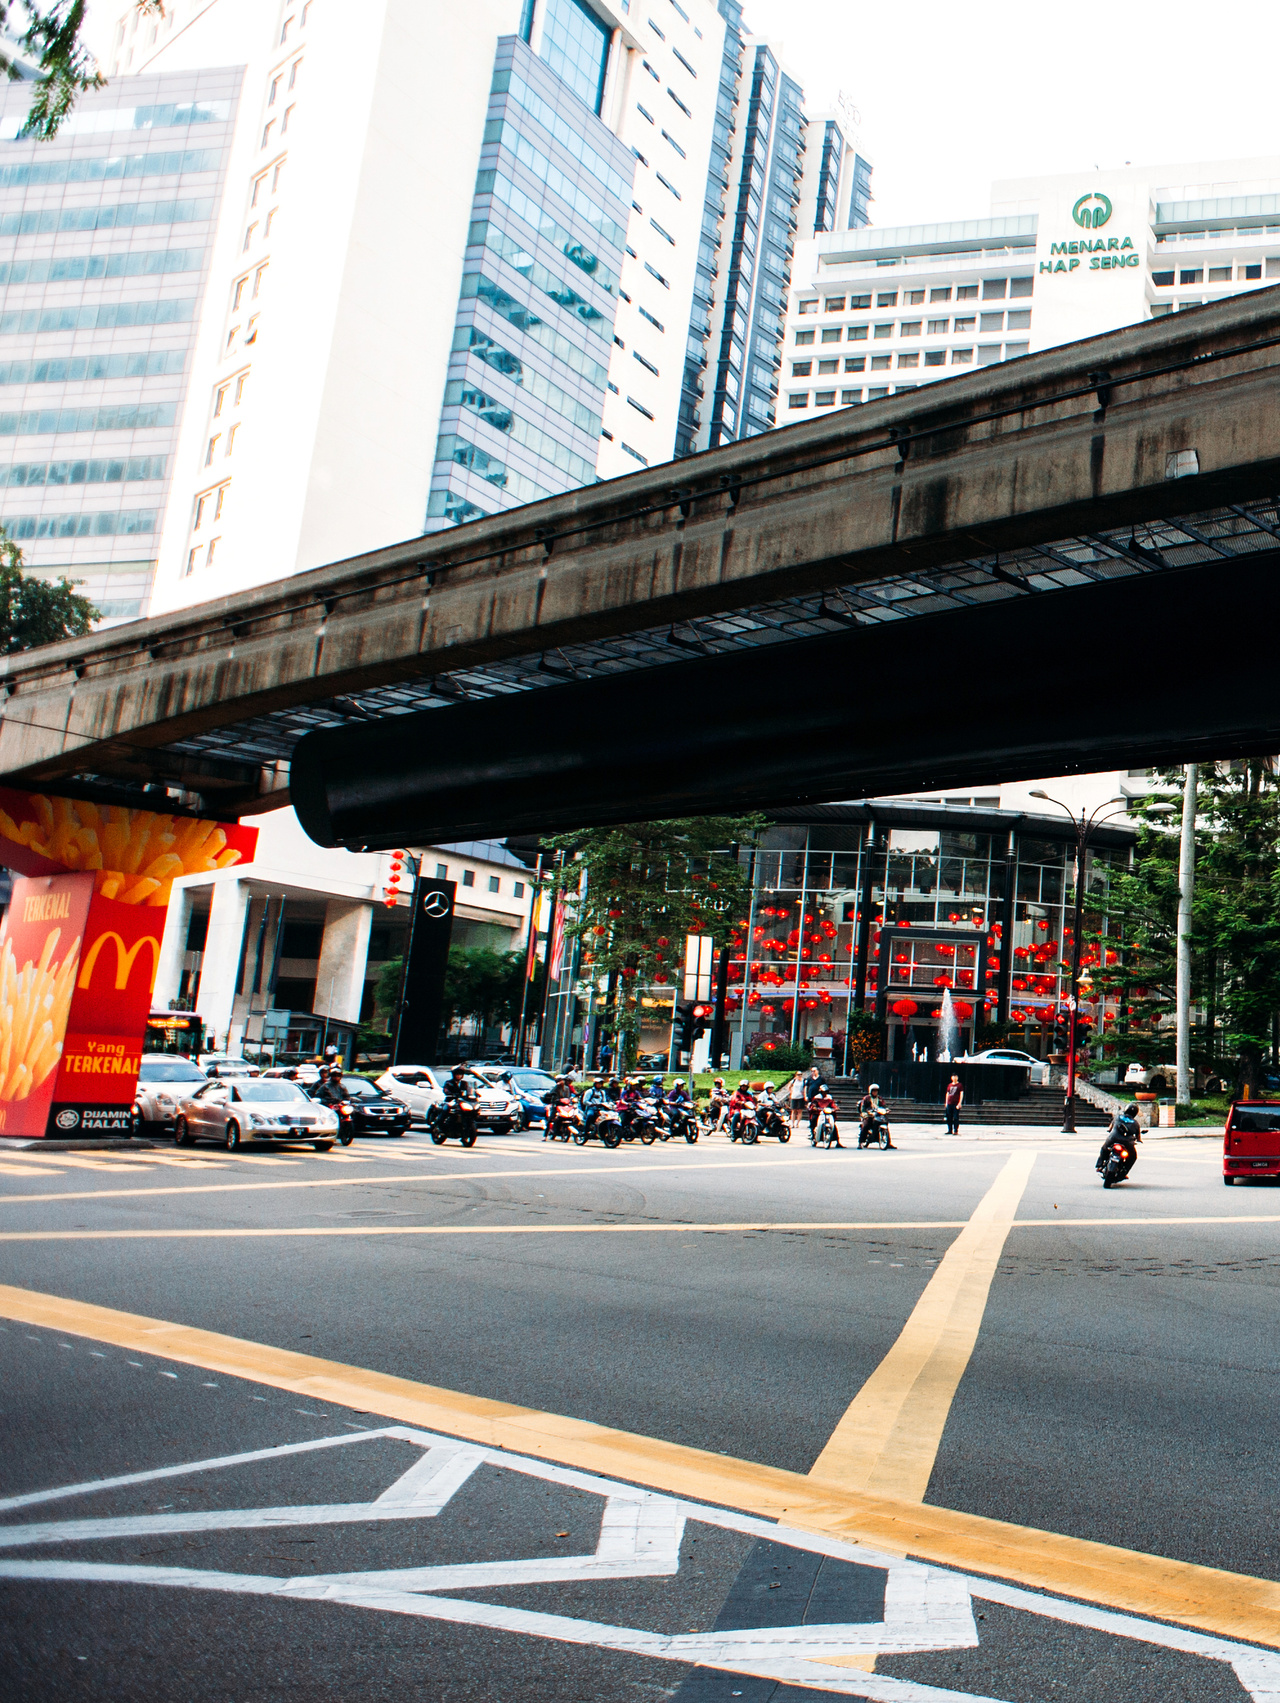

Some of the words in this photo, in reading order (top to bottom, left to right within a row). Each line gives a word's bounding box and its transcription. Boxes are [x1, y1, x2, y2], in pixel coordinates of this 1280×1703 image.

[1050, 236, 1134, 255] MENARA
[1039, 257, 1081, 274] HAP
[1089, 253, 1140, 270] SENG
[23, 892, 72, 923] TERKENAL
[87, 1041, 126, 1057] Yang
[65, 1055, 140, 1075] TERKENAL
[81, 1119, 130, 1128] HALAL
[83, 1110, 132, 1119] DIJAMIN
